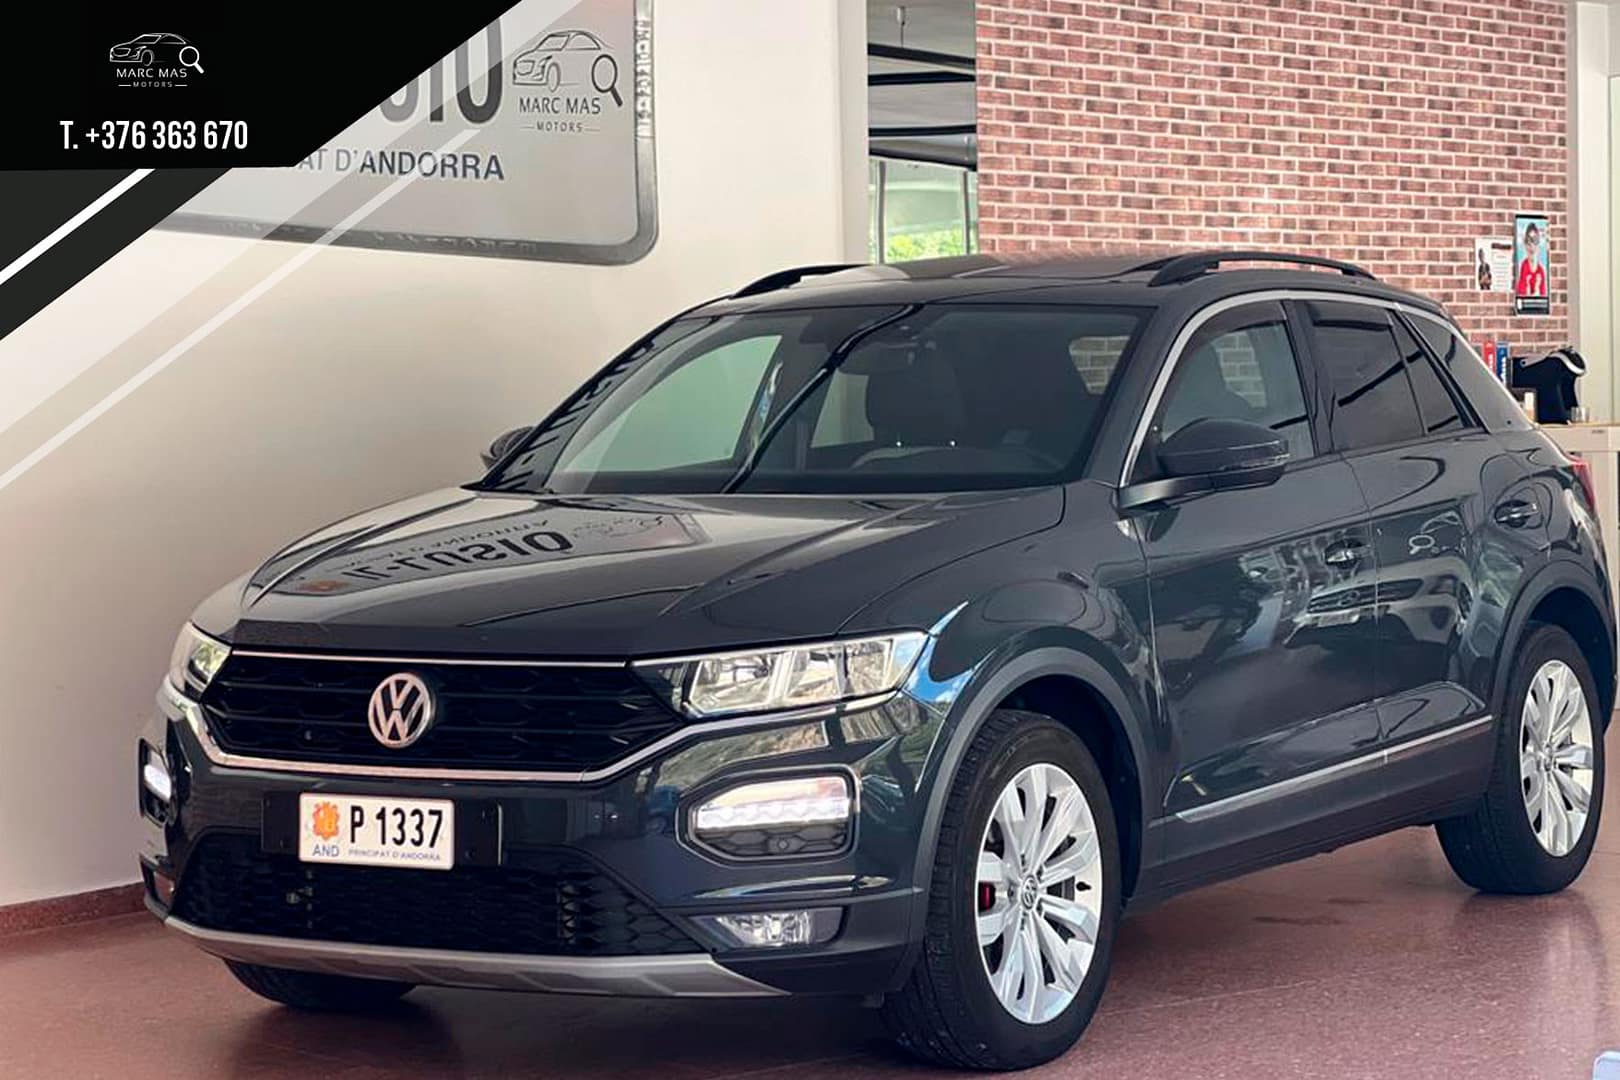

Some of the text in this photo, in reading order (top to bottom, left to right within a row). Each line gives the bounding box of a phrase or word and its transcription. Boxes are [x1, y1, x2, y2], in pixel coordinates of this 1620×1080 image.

[519, 97, 601, 115] MARC MAS
[536, 121, 583, 133] MOTORS
[335, 148, 504, 181] D'ANDORRA
[350, 804, 443, 848] P 1337
[312, 843, 340, 858] AND
